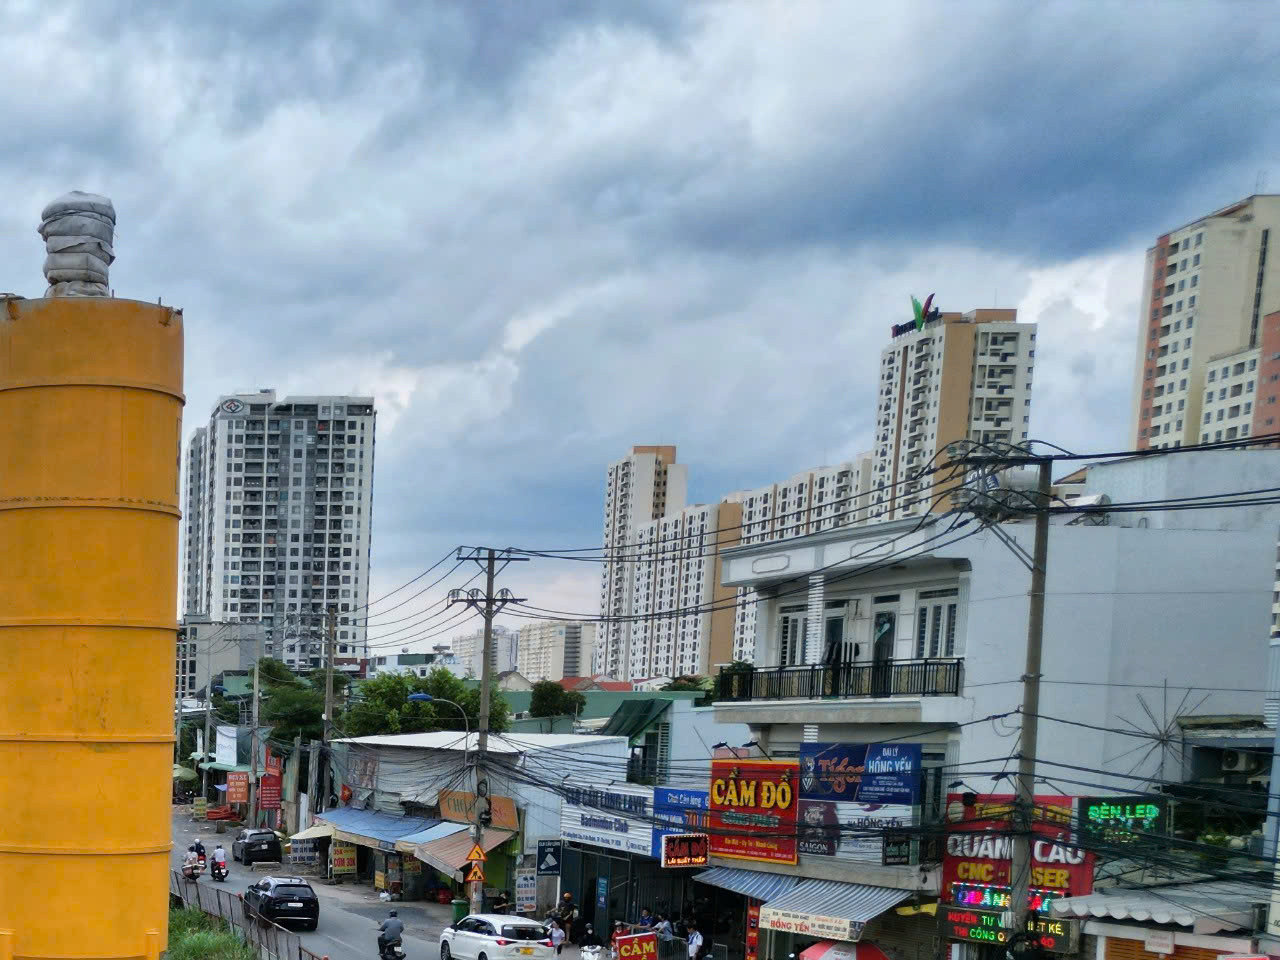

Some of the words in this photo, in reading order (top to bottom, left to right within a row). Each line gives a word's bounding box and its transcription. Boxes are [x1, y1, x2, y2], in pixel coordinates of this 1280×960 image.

[868, 755, 893, 773] HỒNG
[817, 757, 865, 793] Tiger
[711, 766, 757, 808] CẦM
[760, 768, 792, 810] ĐỒ
[1125, 804, 1160, 819] LED
[947, 826, 1015, 860] QUẢN
[957, 862, 993, 882] CNC
[969, 926, 995, 941] CÔNG
[620, 937, 655, 957] CẦM
